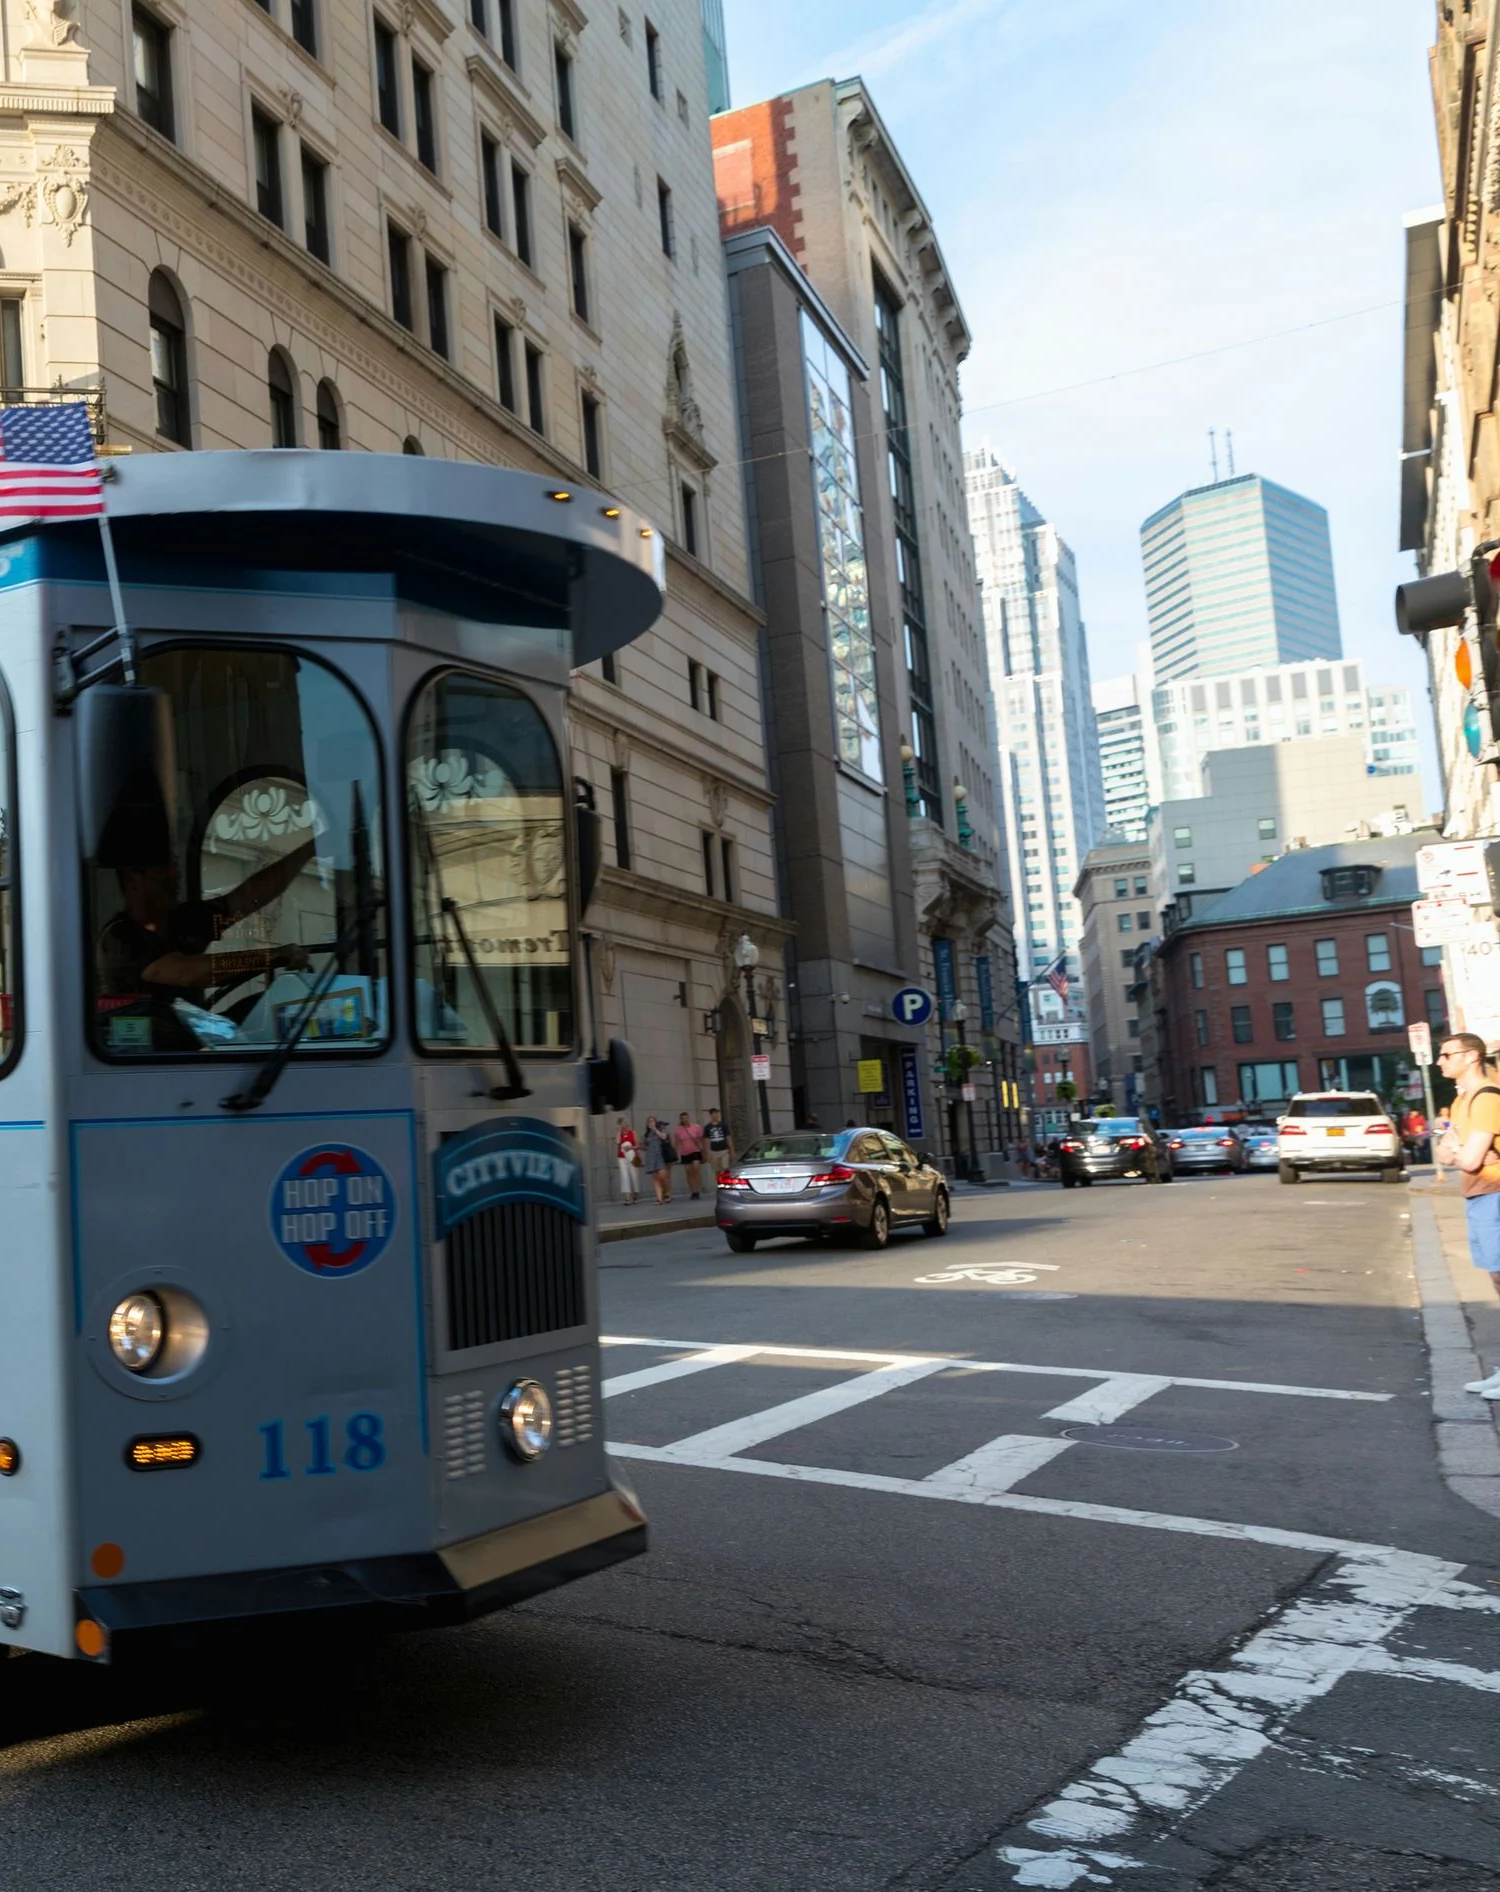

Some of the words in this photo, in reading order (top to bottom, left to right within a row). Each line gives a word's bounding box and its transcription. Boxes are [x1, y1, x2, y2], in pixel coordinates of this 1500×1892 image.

[902, 993, 924, 1021] P
[905, 1061, 920, 1125] PARKING
[283, 1178, 340, 1210] HOP
[346, 1175, 384, 1206] ON
[445, 1149, 577, 1197] CITYVIEW
[281, 1212, 336, 1244] HOP
[343, 1209, 389, 1241] OFF
[258, 1409, 388, 1481] 118
